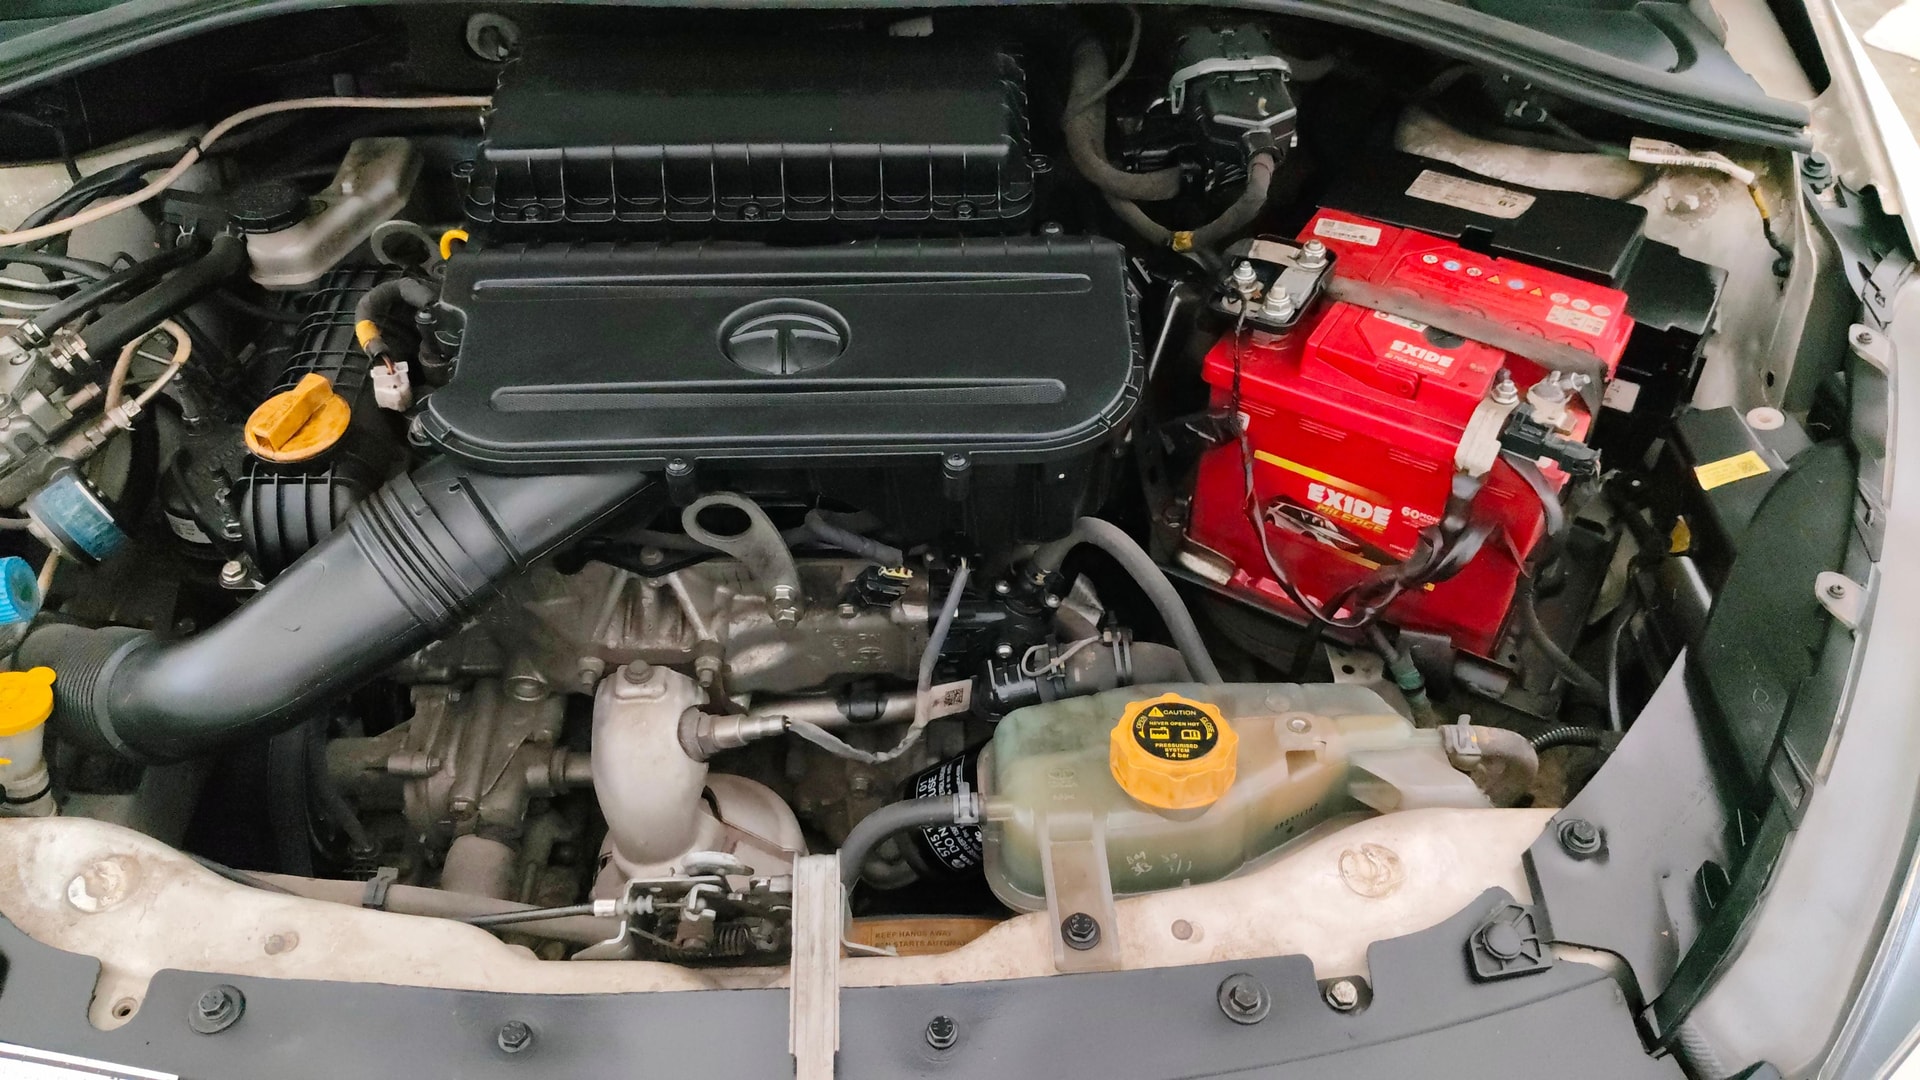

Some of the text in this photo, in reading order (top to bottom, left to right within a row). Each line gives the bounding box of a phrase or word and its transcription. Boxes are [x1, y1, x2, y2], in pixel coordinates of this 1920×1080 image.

[1390, 339, 1455, 368] EXIDE
[1307, 482, 1392, 527] EXIDE
[1316, 504, 1387, 534] MILEAGE
[1401, 506, 1420, 520] 60
[1136, 715, 1148, 729] OPEN
[1201, 717, 1215, 733] CLOSE
[928, 774, 938, 798] USE
[930, 834, 951, 858] 5715
[944, 838, 960, 854] DO
[875, 931, 898, 939] KEEP
[894, 940, 925, 948] STARTS
